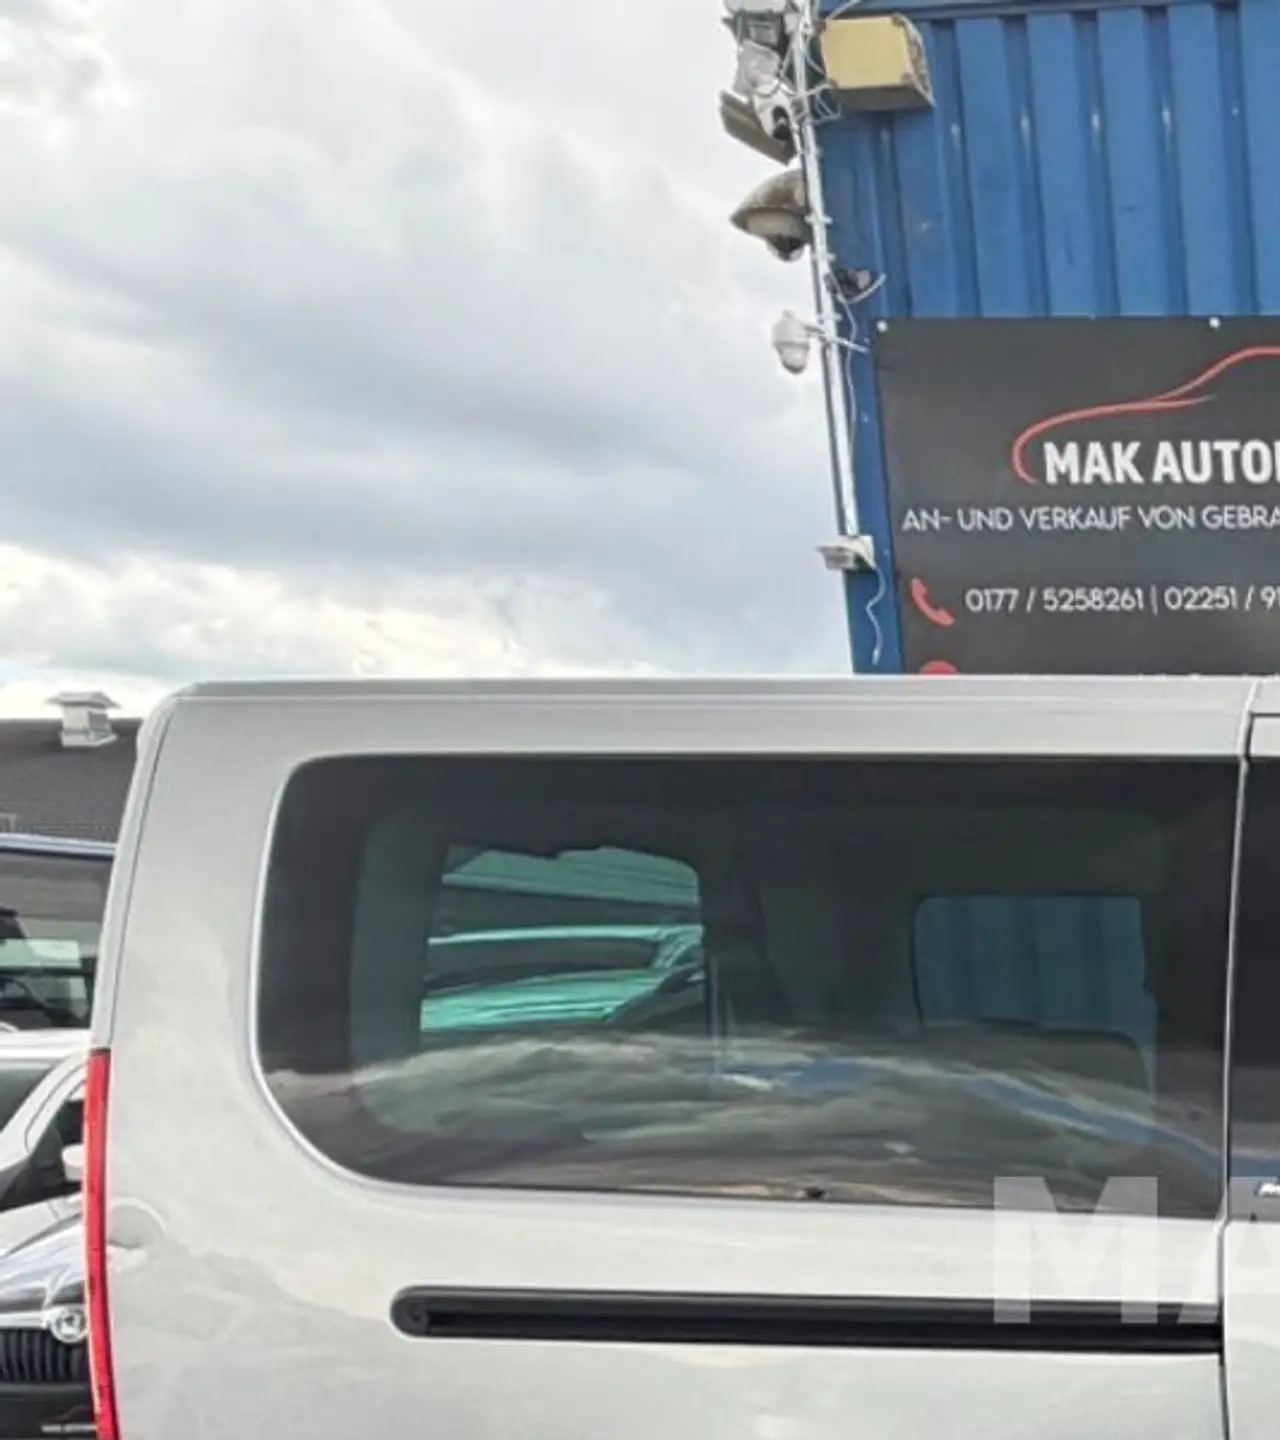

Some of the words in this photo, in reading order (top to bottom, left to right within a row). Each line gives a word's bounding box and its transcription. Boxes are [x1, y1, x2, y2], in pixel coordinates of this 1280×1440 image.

[1042, 440, 1145, 485] MAK
[901, 507, 952, 532] AN-
[956, 507, 1014, 532] UND
[1018, 506, 1132, 531] VERKAUF
[1136, 505, 1196, 531] VON
[964, 587, 1020, 613] 0177
[1042, 586, 1145, 613] 5258261
[1163, 585, 1238, 611] 02251
